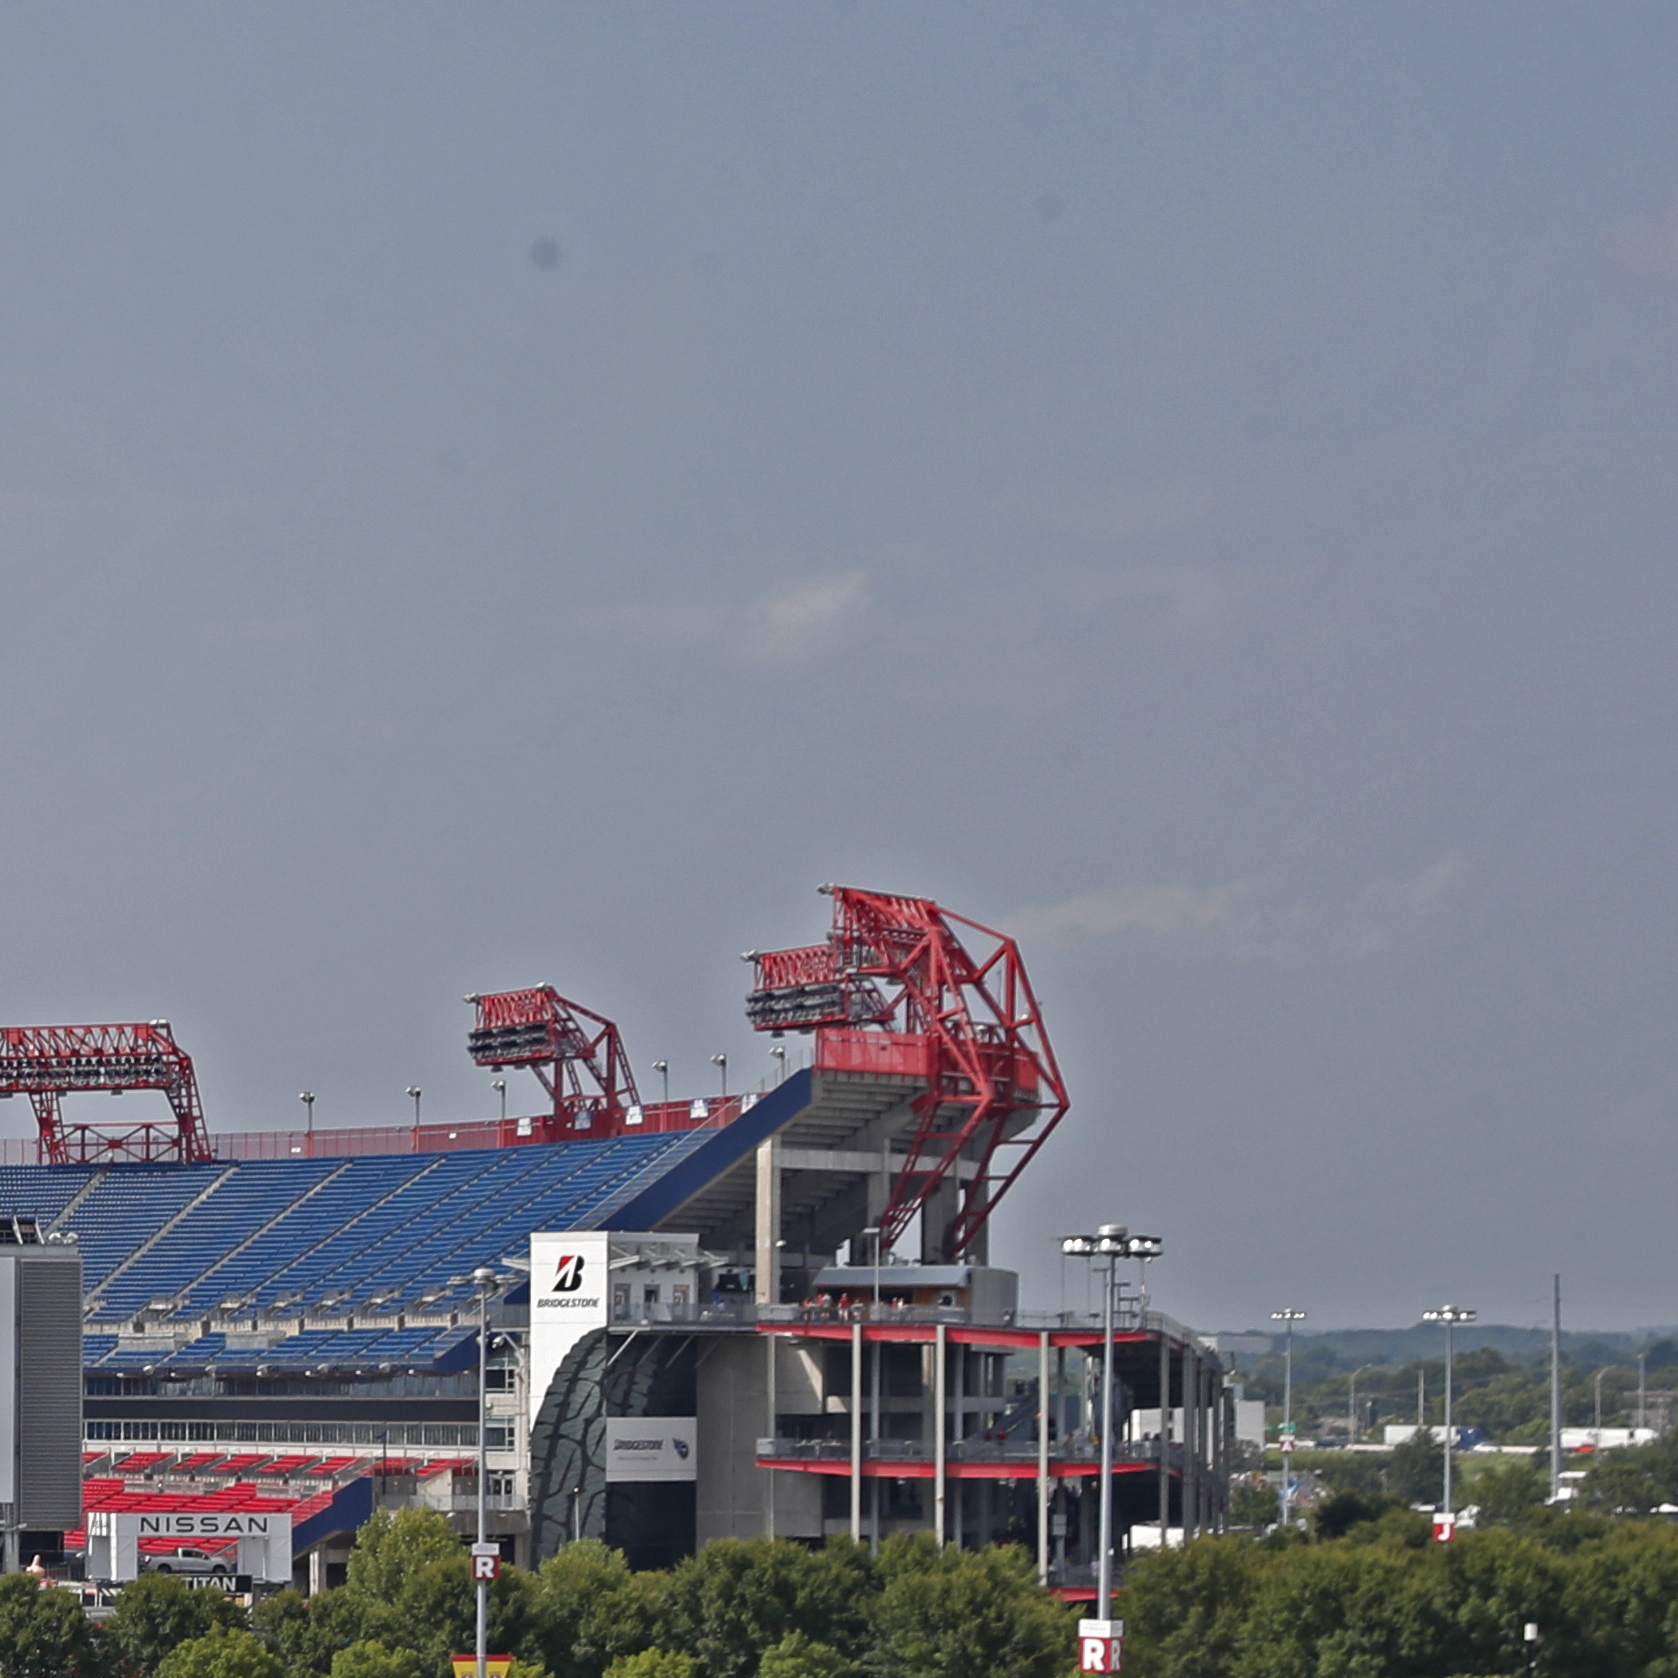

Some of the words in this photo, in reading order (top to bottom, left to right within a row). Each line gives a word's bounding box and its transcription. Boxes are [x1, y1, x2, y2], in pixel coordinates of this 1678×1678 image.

[536, 1297, 601, 1308] BRIDGESTONE
[140, 1517, 268, 1533] NISSAN
[1438, 1523, 1451, 1541] J
[475, 1556, 495, 1578] R
[184, 1577, 237, 1592] TITAN
[1082, 1638, 1105, 1671] R
[1110, 1639, 1121, 1671] R
